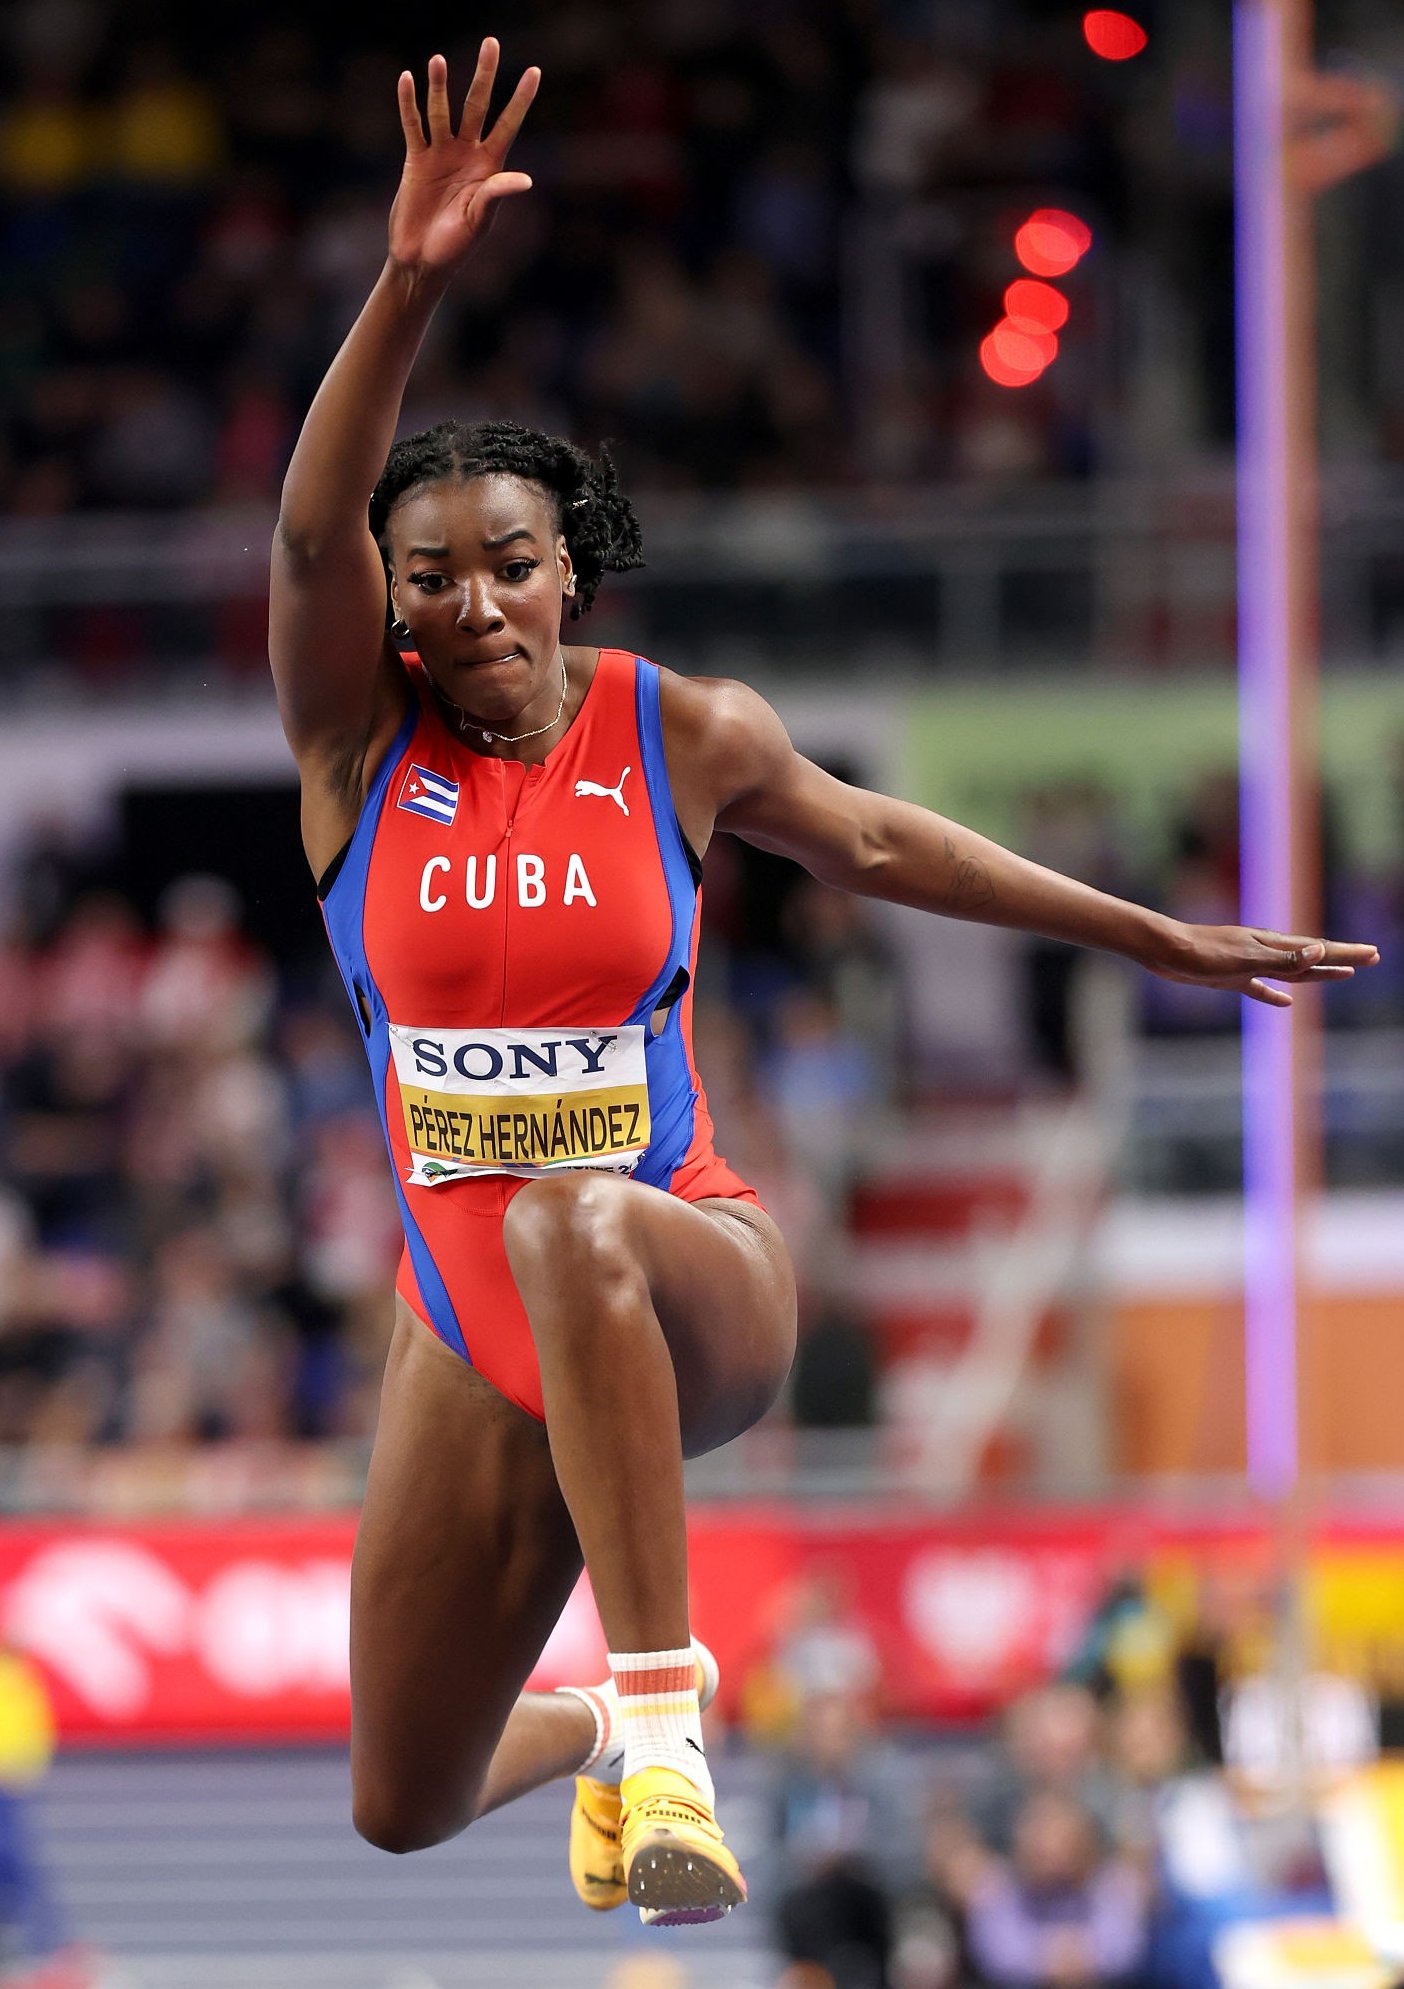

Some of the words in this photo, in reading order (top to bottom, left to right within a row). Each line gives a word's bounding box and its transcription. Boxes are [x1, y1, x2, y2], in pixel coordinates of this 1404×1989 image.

[419, 853, 598, 913] CUBA
[412, 1035, 618, 1081] SONY
[409, 1095, 475, 1158] PÉREZ
[479, 1098, 641, 1160] HERNÁNDEZ
